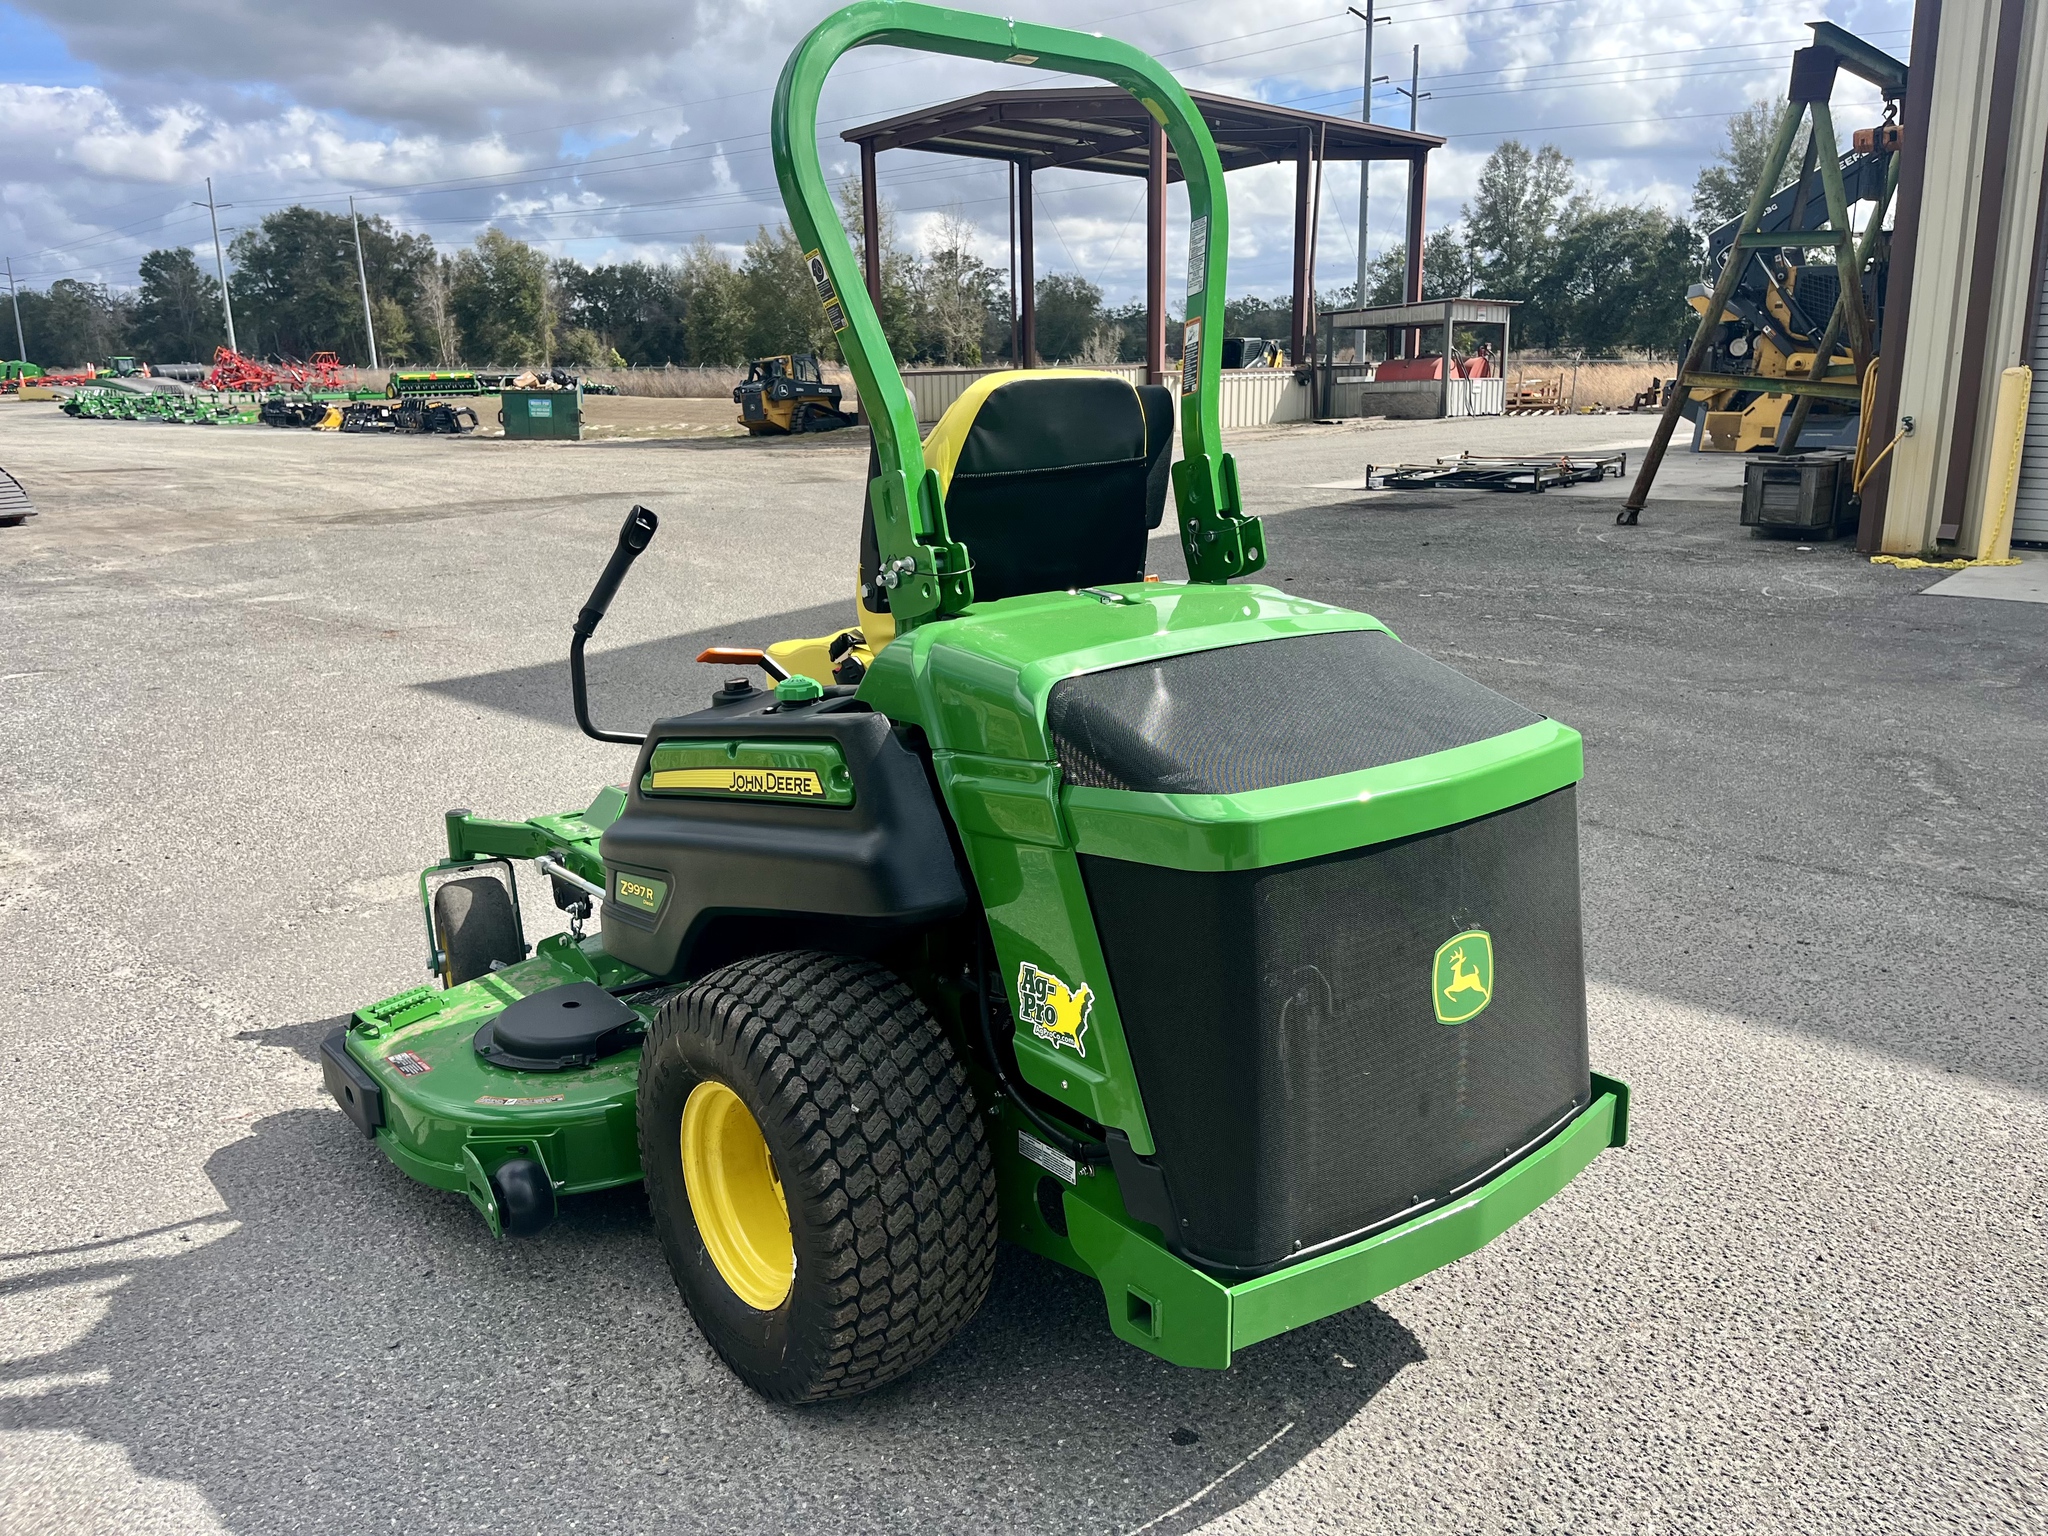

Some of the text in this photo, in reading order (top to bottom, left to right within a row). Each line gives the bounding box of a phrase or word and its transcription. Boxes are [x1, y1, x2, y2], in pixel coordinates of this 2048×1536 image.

[729, 771, 812, 793] JOHN DEERE
[620, 880, 654, 900] Z997R
[1021, 966, 1056, 1001] Ag-
[1022, 992, 1057, 1026] Pro
[1034, 1024, 1076, 1046] AgProCo.com
